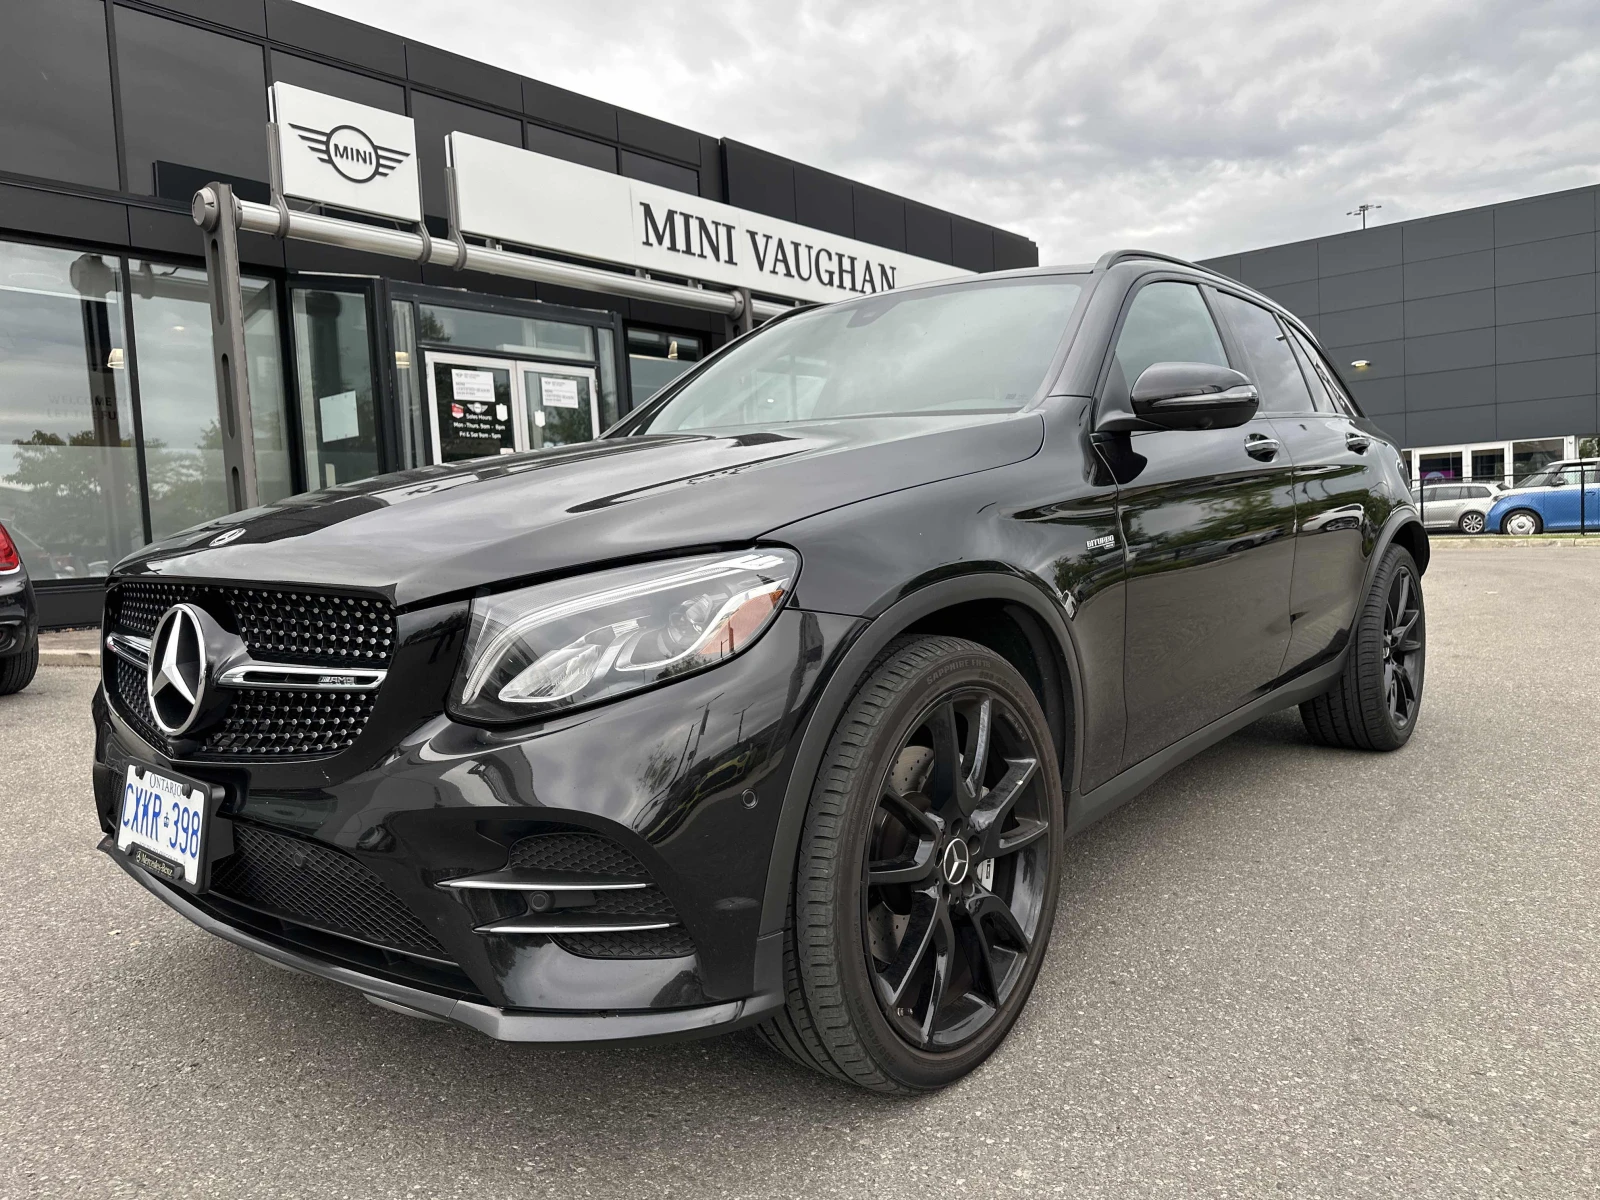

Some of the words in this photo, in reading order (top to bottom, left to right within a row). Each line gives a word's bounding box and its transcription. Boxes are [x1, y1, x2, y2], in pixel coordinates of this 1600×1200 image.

[333, 143, 372, 165] MINI
[640, 201, 737, 266] MINI
[745, 229, 896, 293] VAUGHAN
[926, 659, 970, 685] SAPPHIRE
[169, 802, 201, 859] 398
